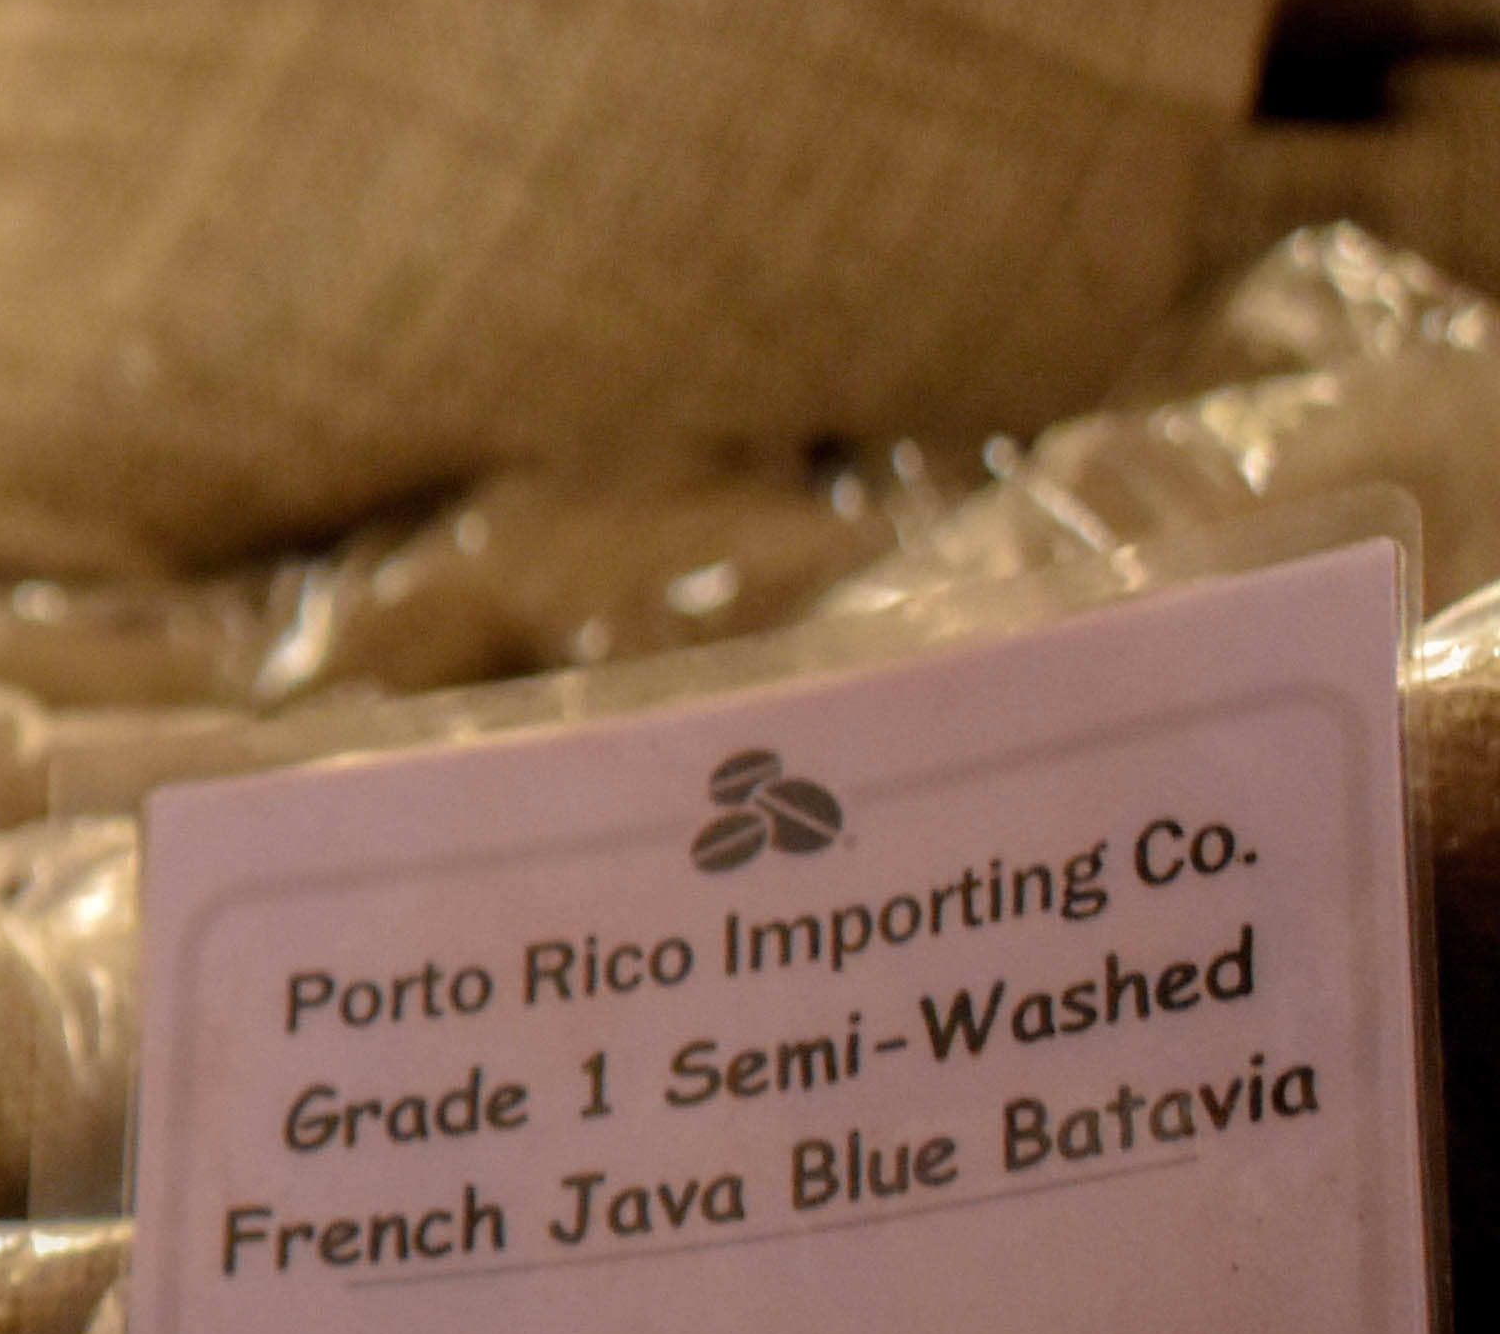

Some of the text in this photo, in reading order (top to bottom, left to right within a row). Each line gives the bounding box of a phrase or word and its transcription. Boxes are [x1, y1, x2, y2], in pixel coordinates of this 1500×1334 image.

[285, 816, 1259, 1035] Porto Rico Importing Co.
[283, 923, 1254, 1153] Grade 1 Semi-Washed
[222, 1053, 1321, 1276] French Java Blue Batavia
